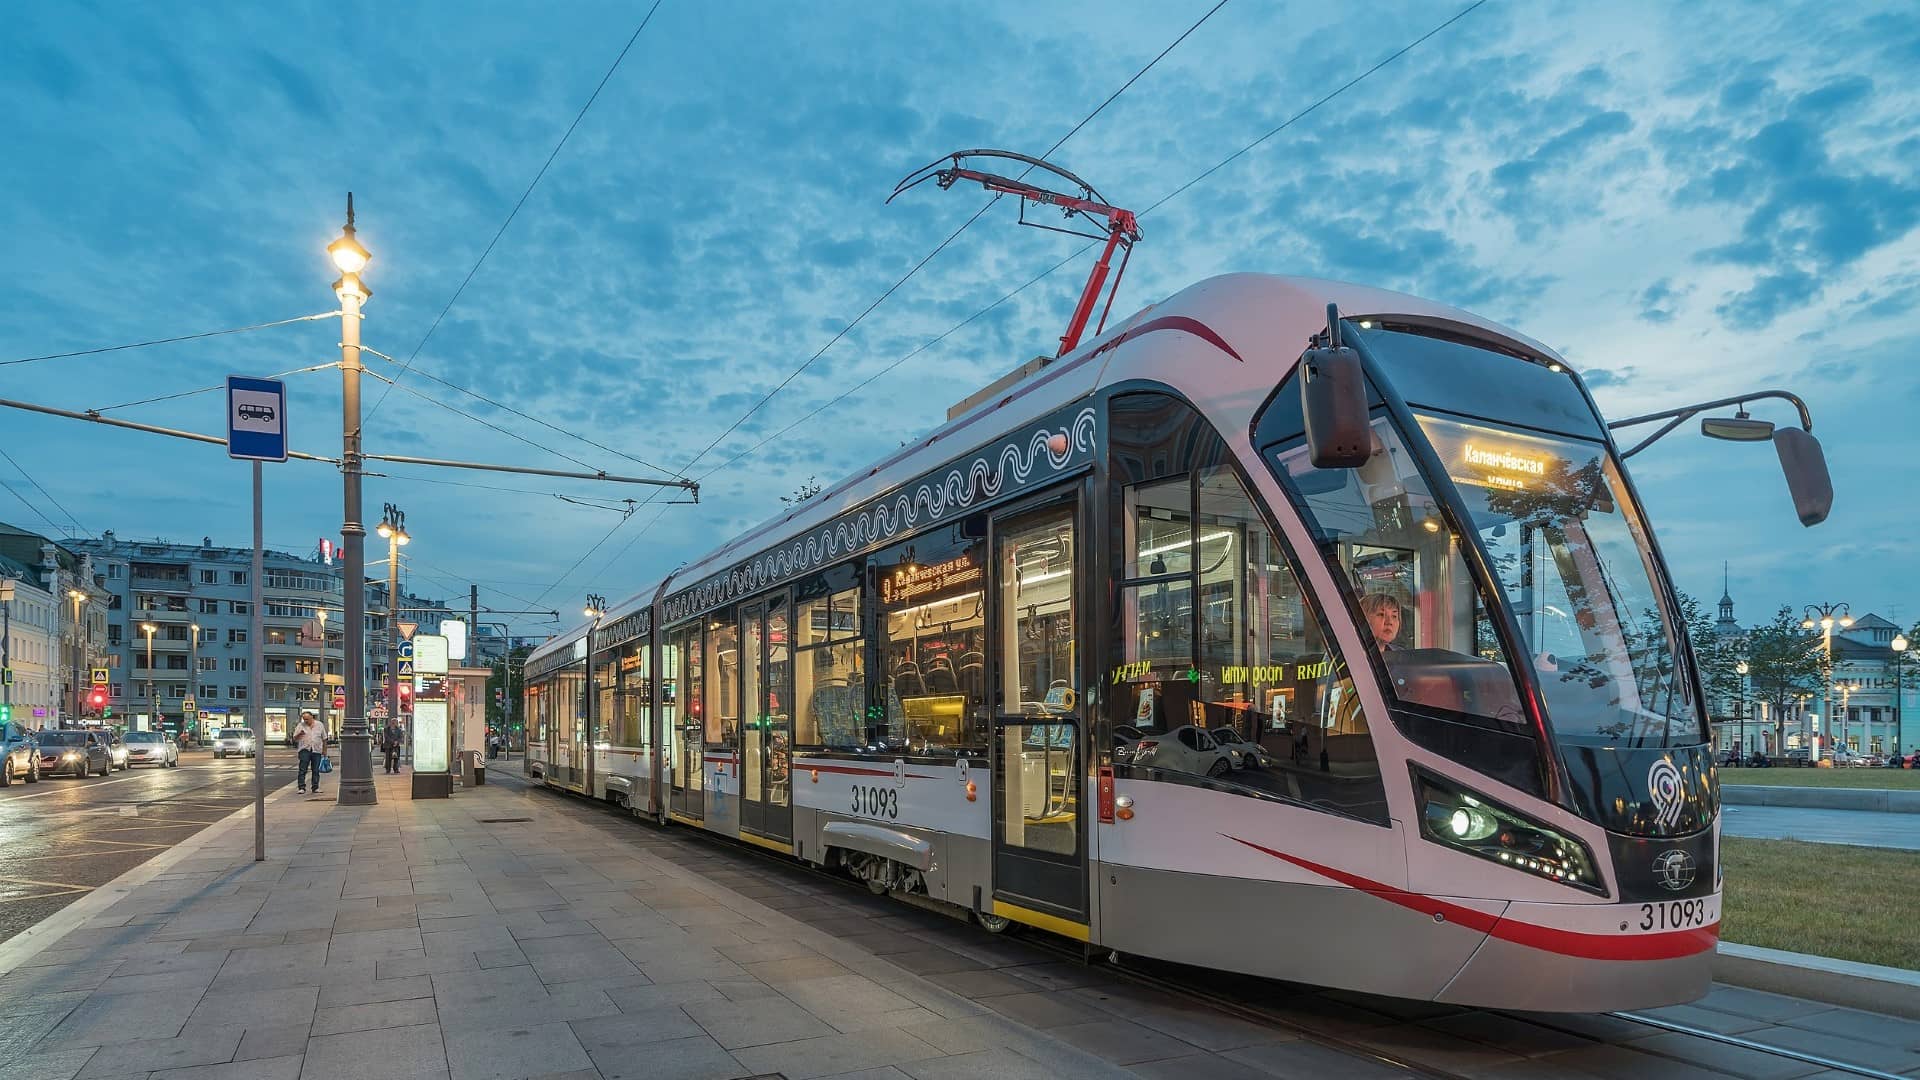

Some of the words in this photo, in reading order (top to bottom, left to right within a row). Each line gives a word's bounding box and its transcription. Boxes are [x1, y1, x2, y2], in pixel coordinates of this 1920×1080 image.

[1464, 443, 1544, 475] Каланчёвская
[884, 578, 891, 604] 9
[851, 784, 898, 819] 31093
[1640, 900, 1704, 931] 31093
